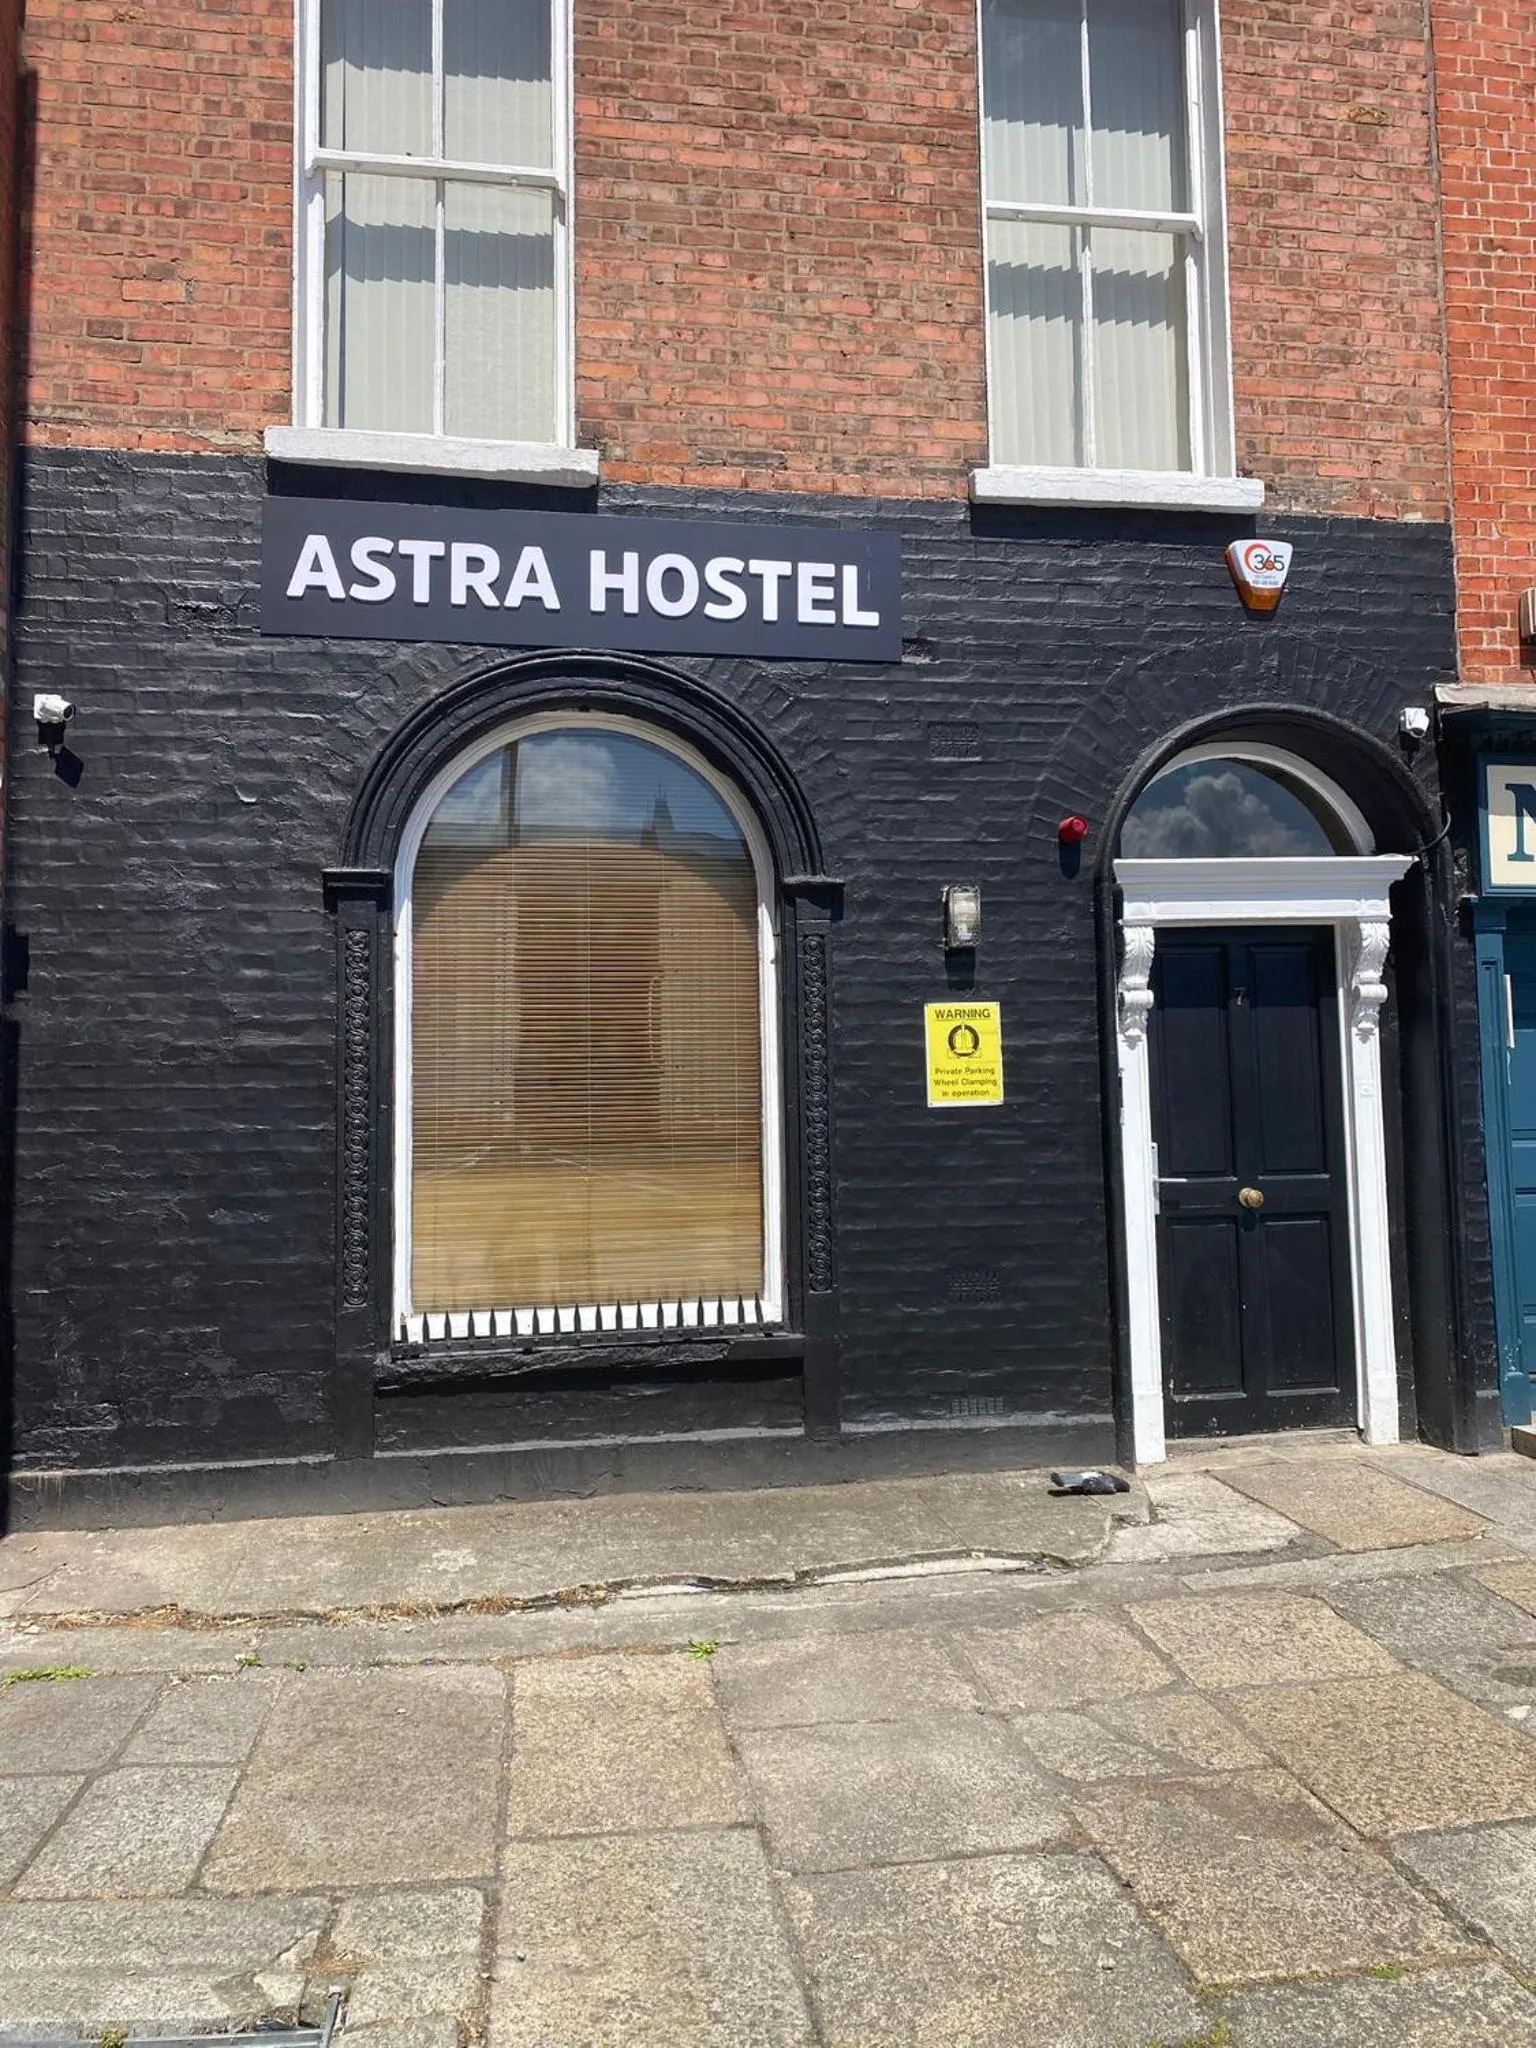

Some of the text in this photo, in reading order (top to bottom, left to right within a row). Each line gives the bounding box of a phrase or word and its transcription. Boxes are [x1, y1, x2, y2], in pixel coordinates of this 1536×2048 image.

[286, 533, 880, 627] ASTRA HOSTEL
[1234, 987, 1245, 1005] 7
[935, 1008, 991, 1019] WARNING
[965, 1067, 995, 1075] Parking
[961, 1078, 998, 1086] Clamping
[952, 1089, 990, 1097] operation
